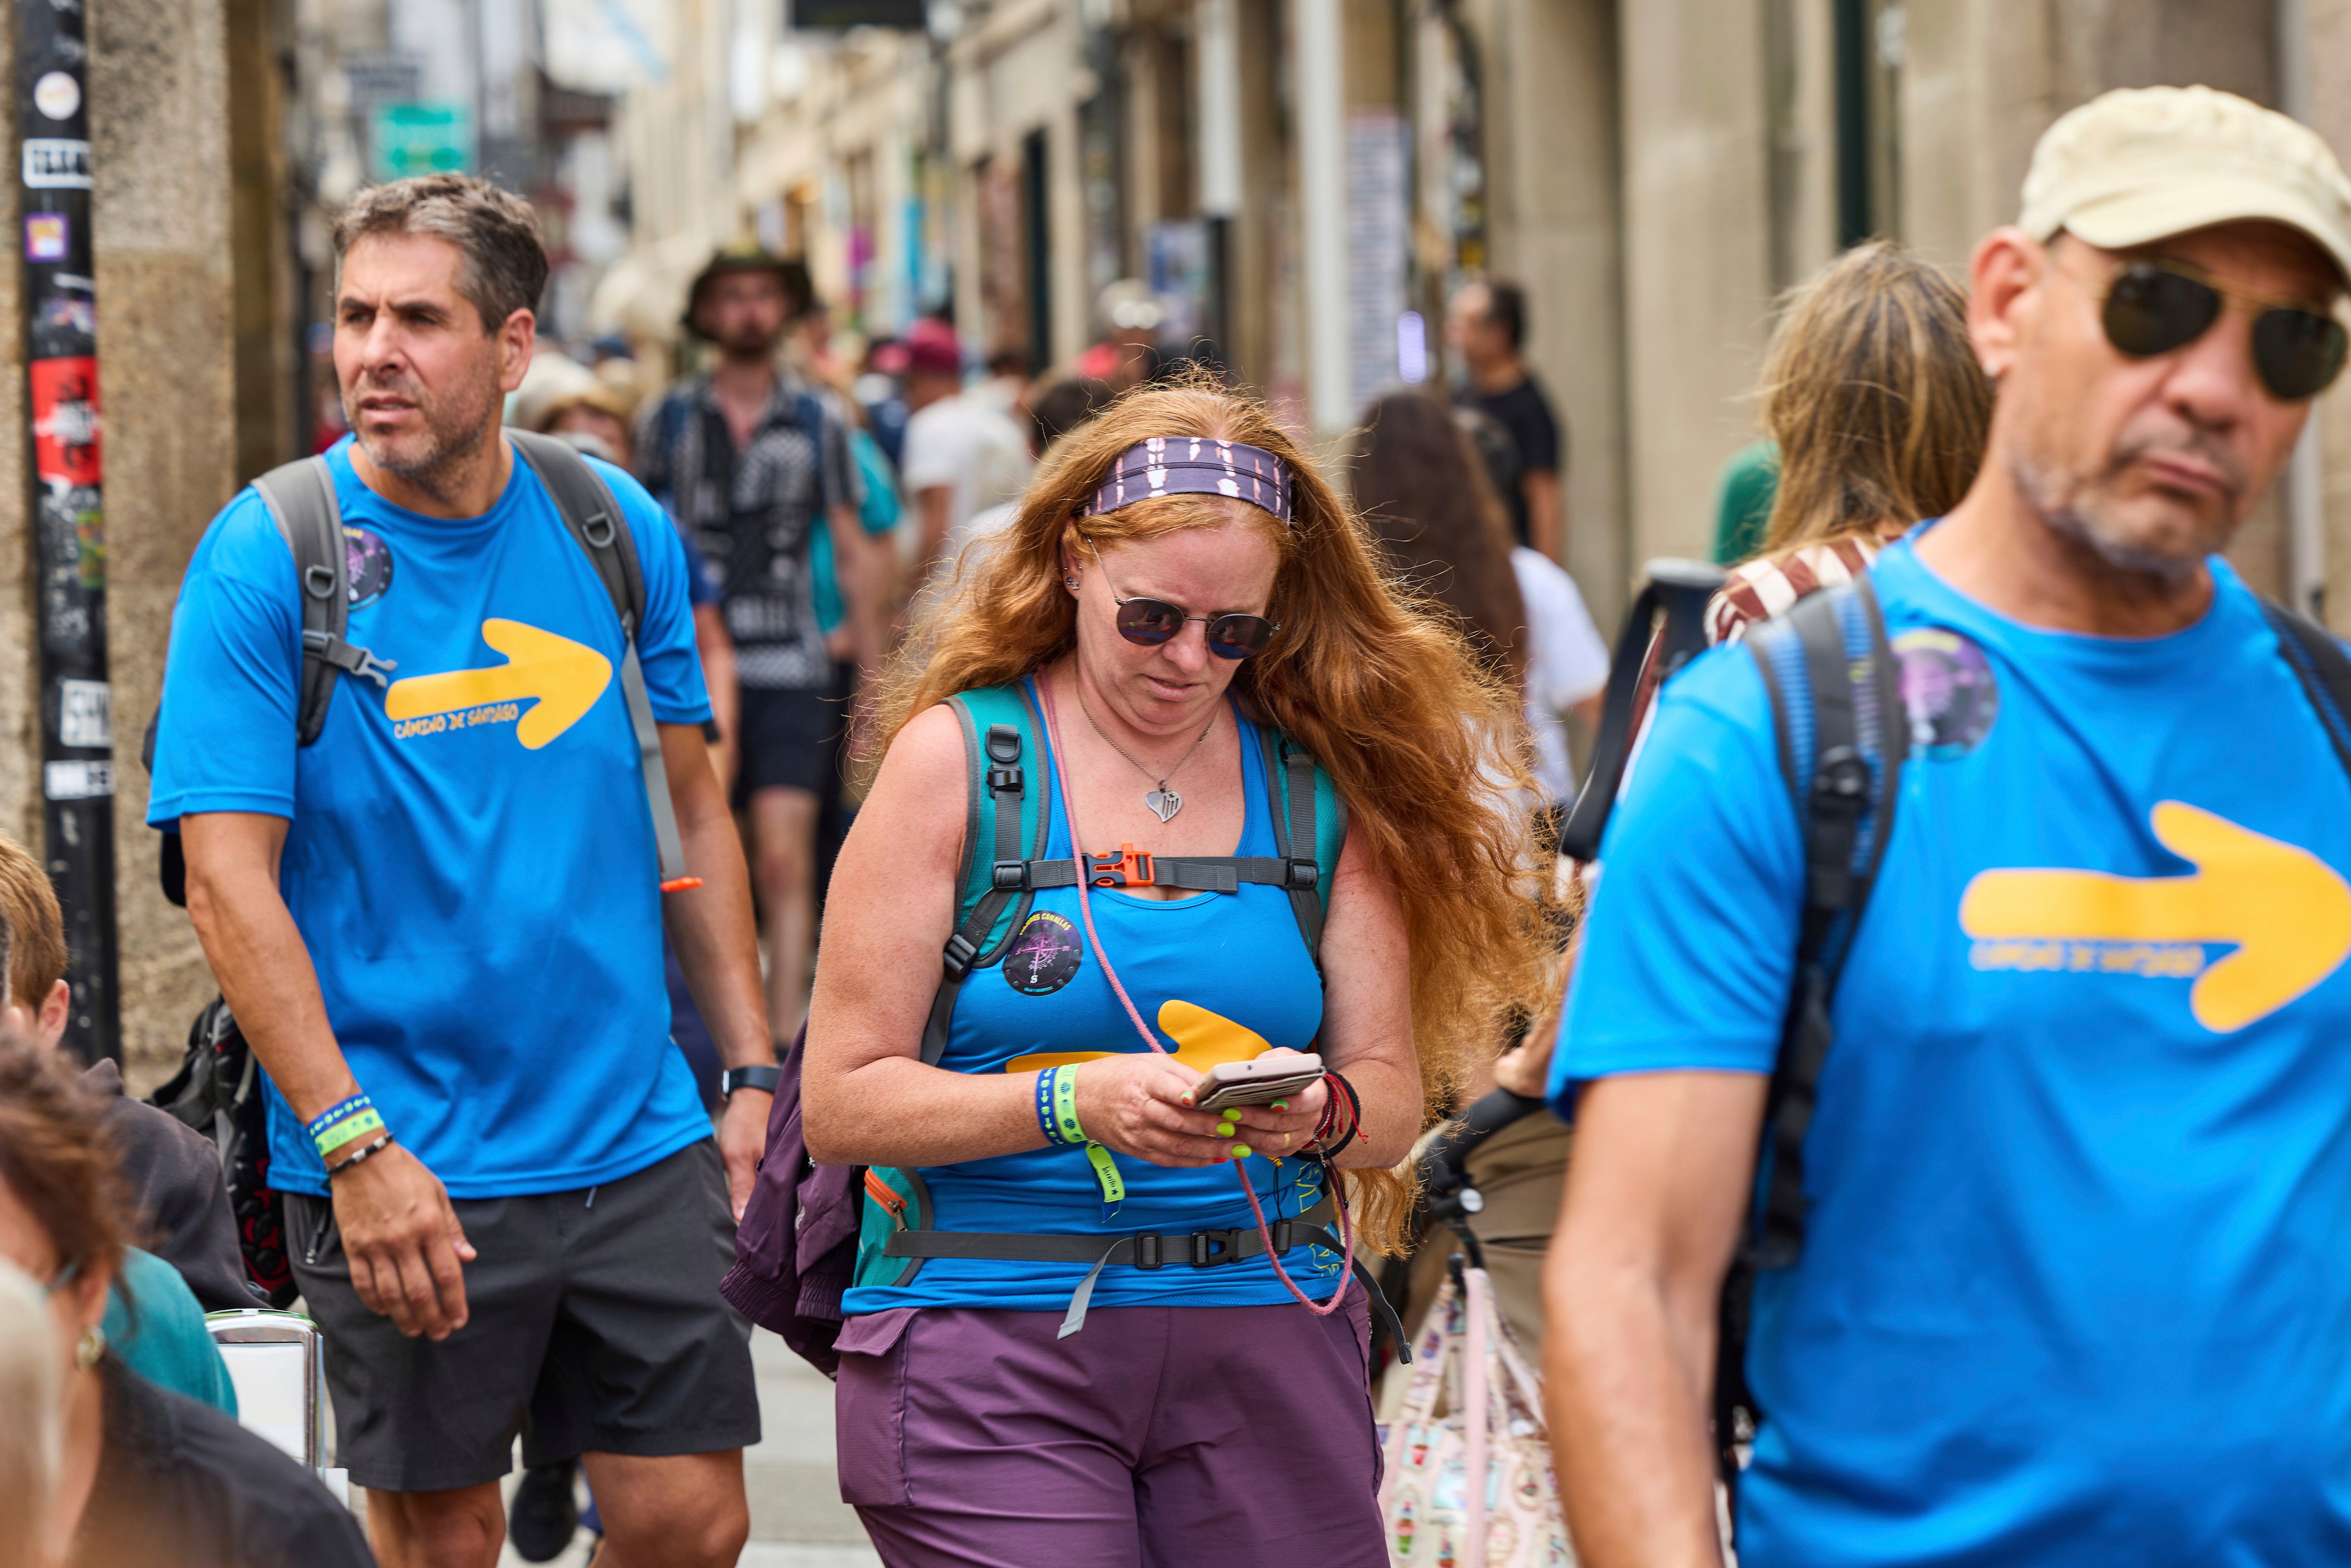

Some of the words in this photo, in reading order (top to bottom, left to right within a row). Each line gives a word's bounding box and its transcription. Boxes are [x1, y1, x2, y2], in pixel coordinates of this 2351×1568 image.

[394, 715, 446, 739] CAMINO
[447, 712, 465, 731] DE
[467, 703, 519, 726] SANTIAGO
[1041, 913, 1072, 930] CANALLAS
[1030, 975, 1038, 984] S
